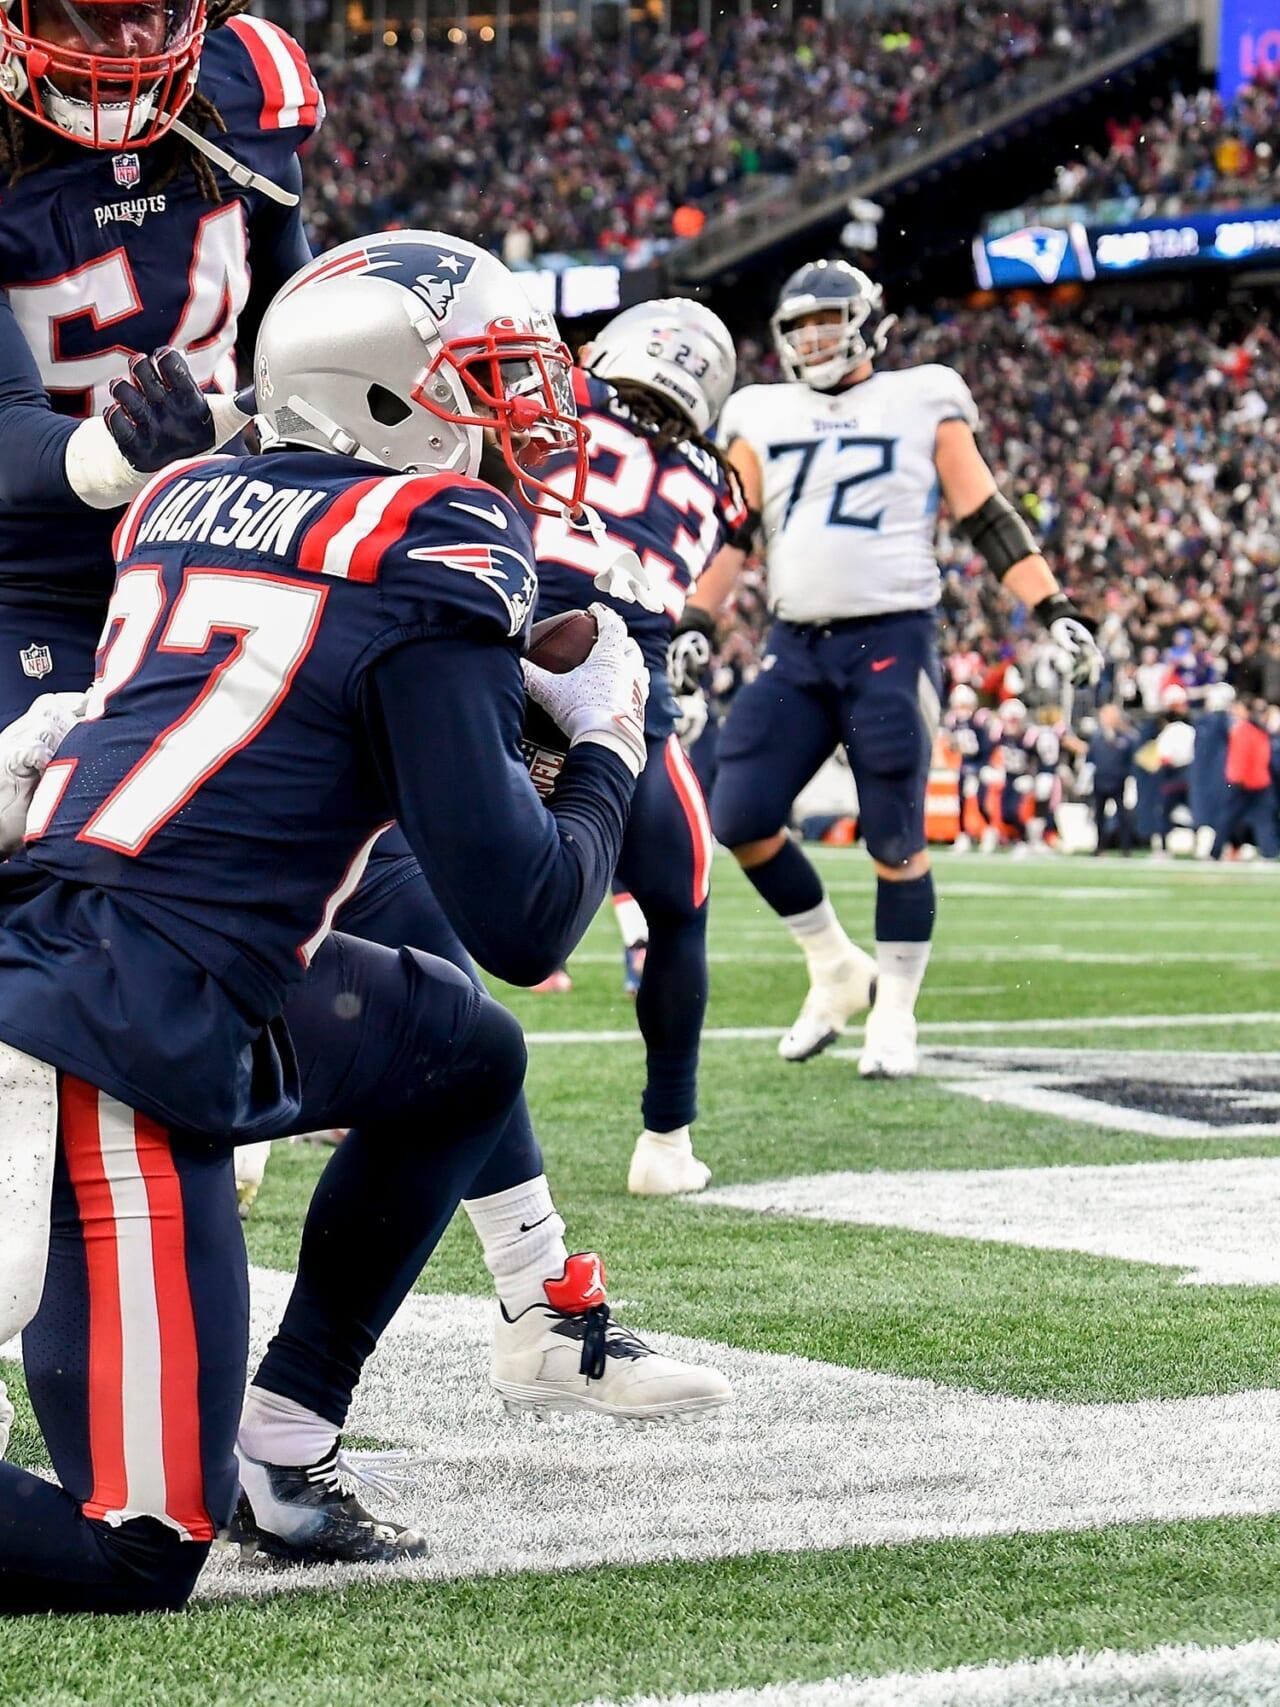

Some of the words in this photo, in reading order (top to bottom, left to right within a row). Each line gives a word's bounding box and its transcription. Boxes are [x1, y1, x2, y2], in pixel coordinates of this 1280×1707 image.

[94, 194, 166, 228] PATRIOTS
[1, 198, 252, 418] 54
[674, 343, 710, 378] 23
[136, 475, 328, 557] JACKSON
[766, 436, 901, 531] 72
[23, 563, 331, 858] 27
